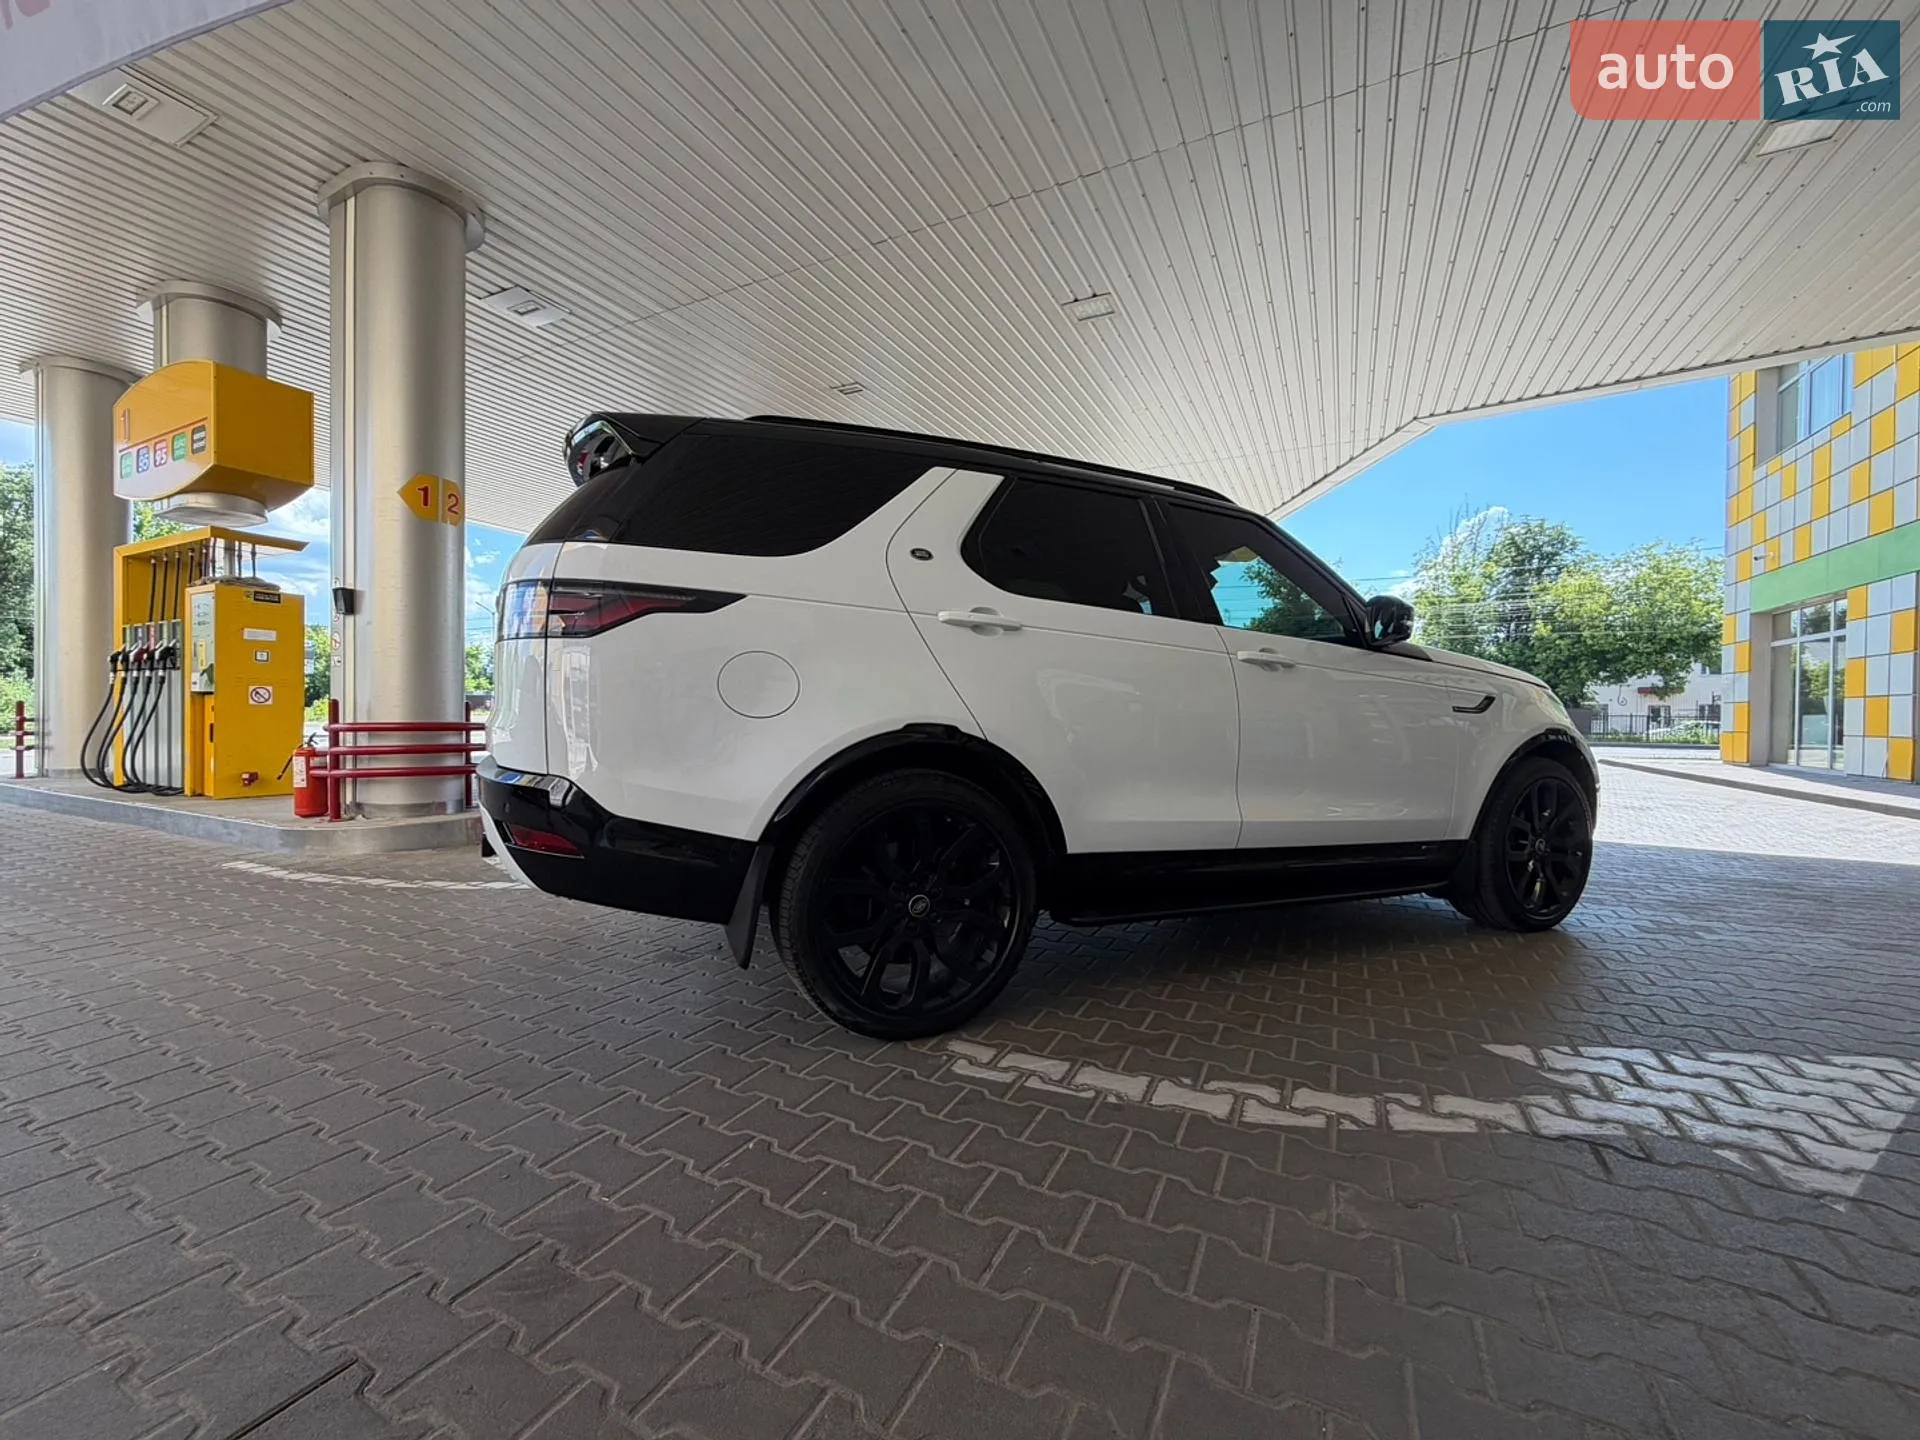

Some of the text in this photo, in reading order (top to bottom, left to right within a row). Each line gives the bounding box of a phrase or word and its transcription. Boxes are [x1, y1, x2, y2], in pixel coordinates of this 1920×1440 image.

[155, 448, 167, 467] 95
[417, 485, 430, 507] 1
[447, 493, 460, 515] 2
